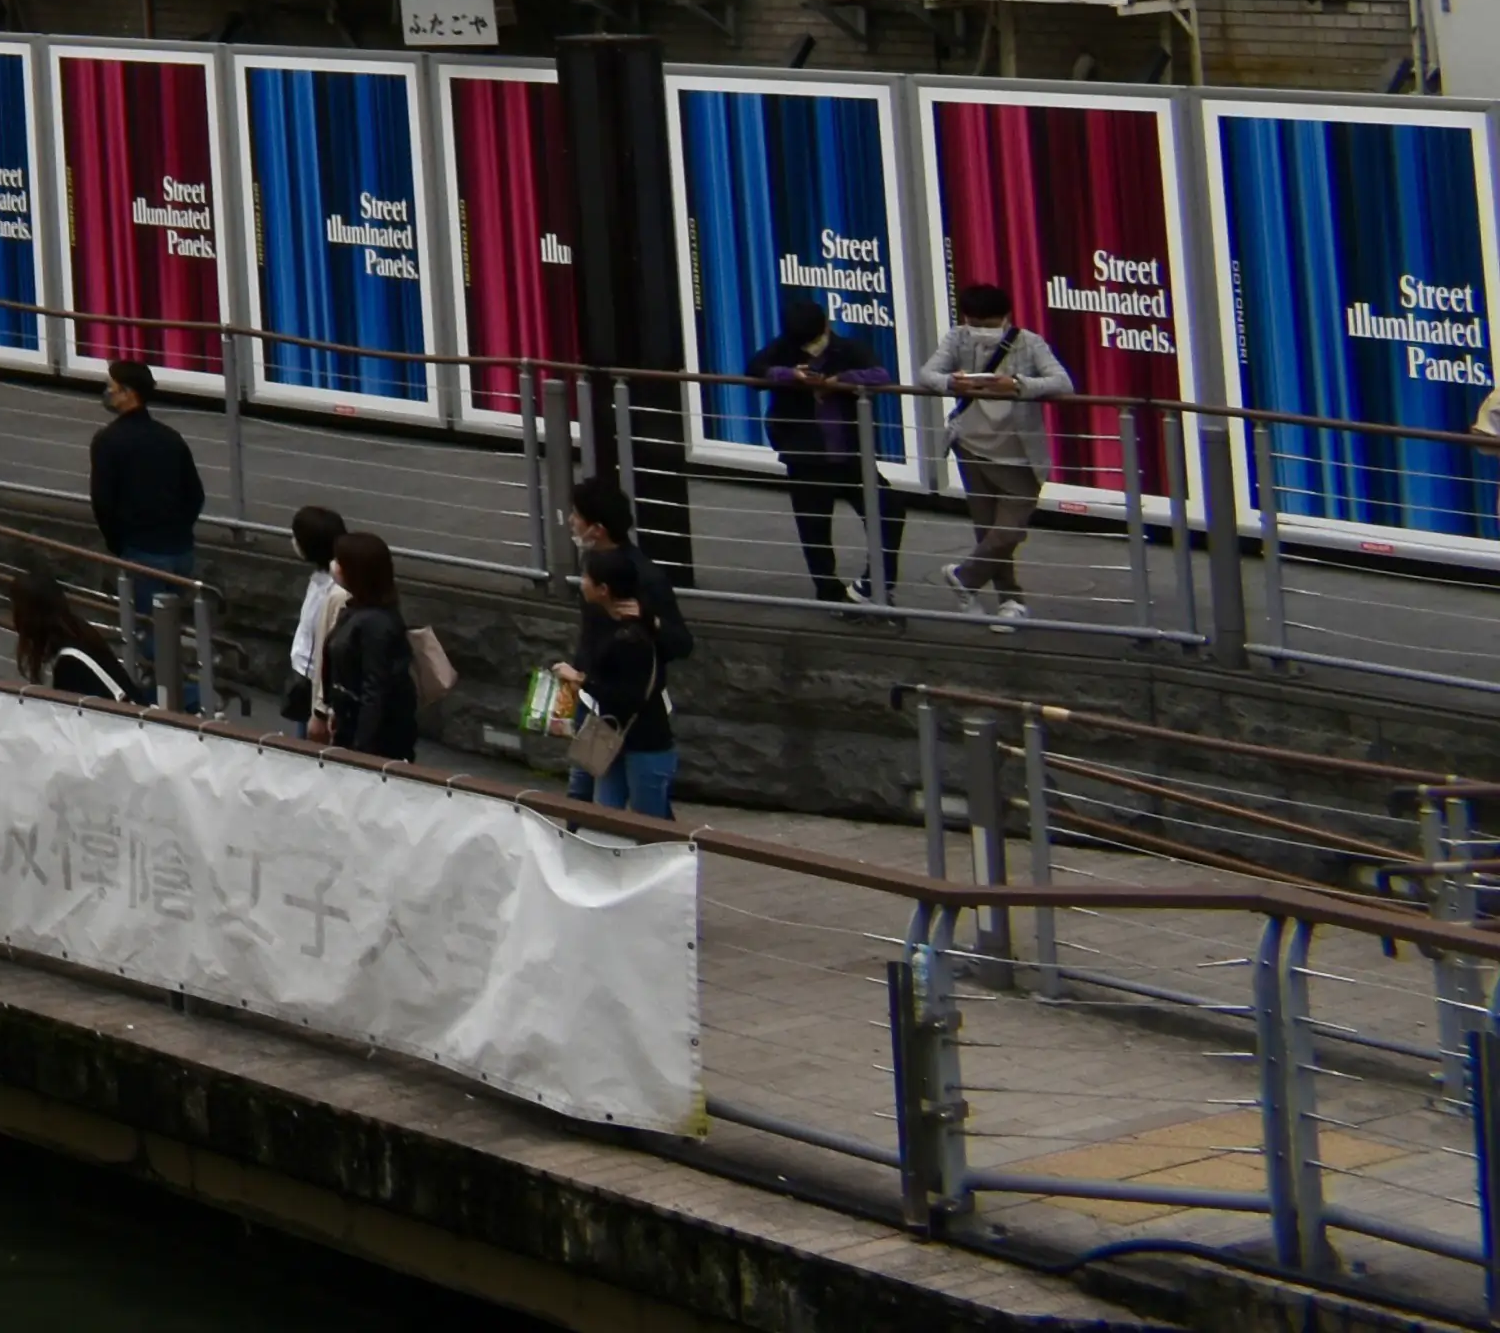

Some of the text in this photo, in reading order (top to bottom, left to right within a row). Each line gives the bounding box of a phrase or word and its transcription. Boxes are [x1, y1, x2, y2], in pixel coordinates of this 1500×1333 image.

[408, 12, 490, 38] ふたごや
[162, 175, 207, 204] Street
[360, 190, 408, 223] Street
[166, 229, 217, 260] Panels.
[821, 228, 880, 263] Street
[365, 247, 420, 280] Panels.
[1093, 249, 1159, 286] Street
[828, 292, 895, 328] Panels.
[1400, 273, 1474, 314] Street
[1231, 258, 1249, 365] DOTONBORI
[1101, 316, 1176, 355] Panels.
[1407, 344, 1494, 388] Panels.
